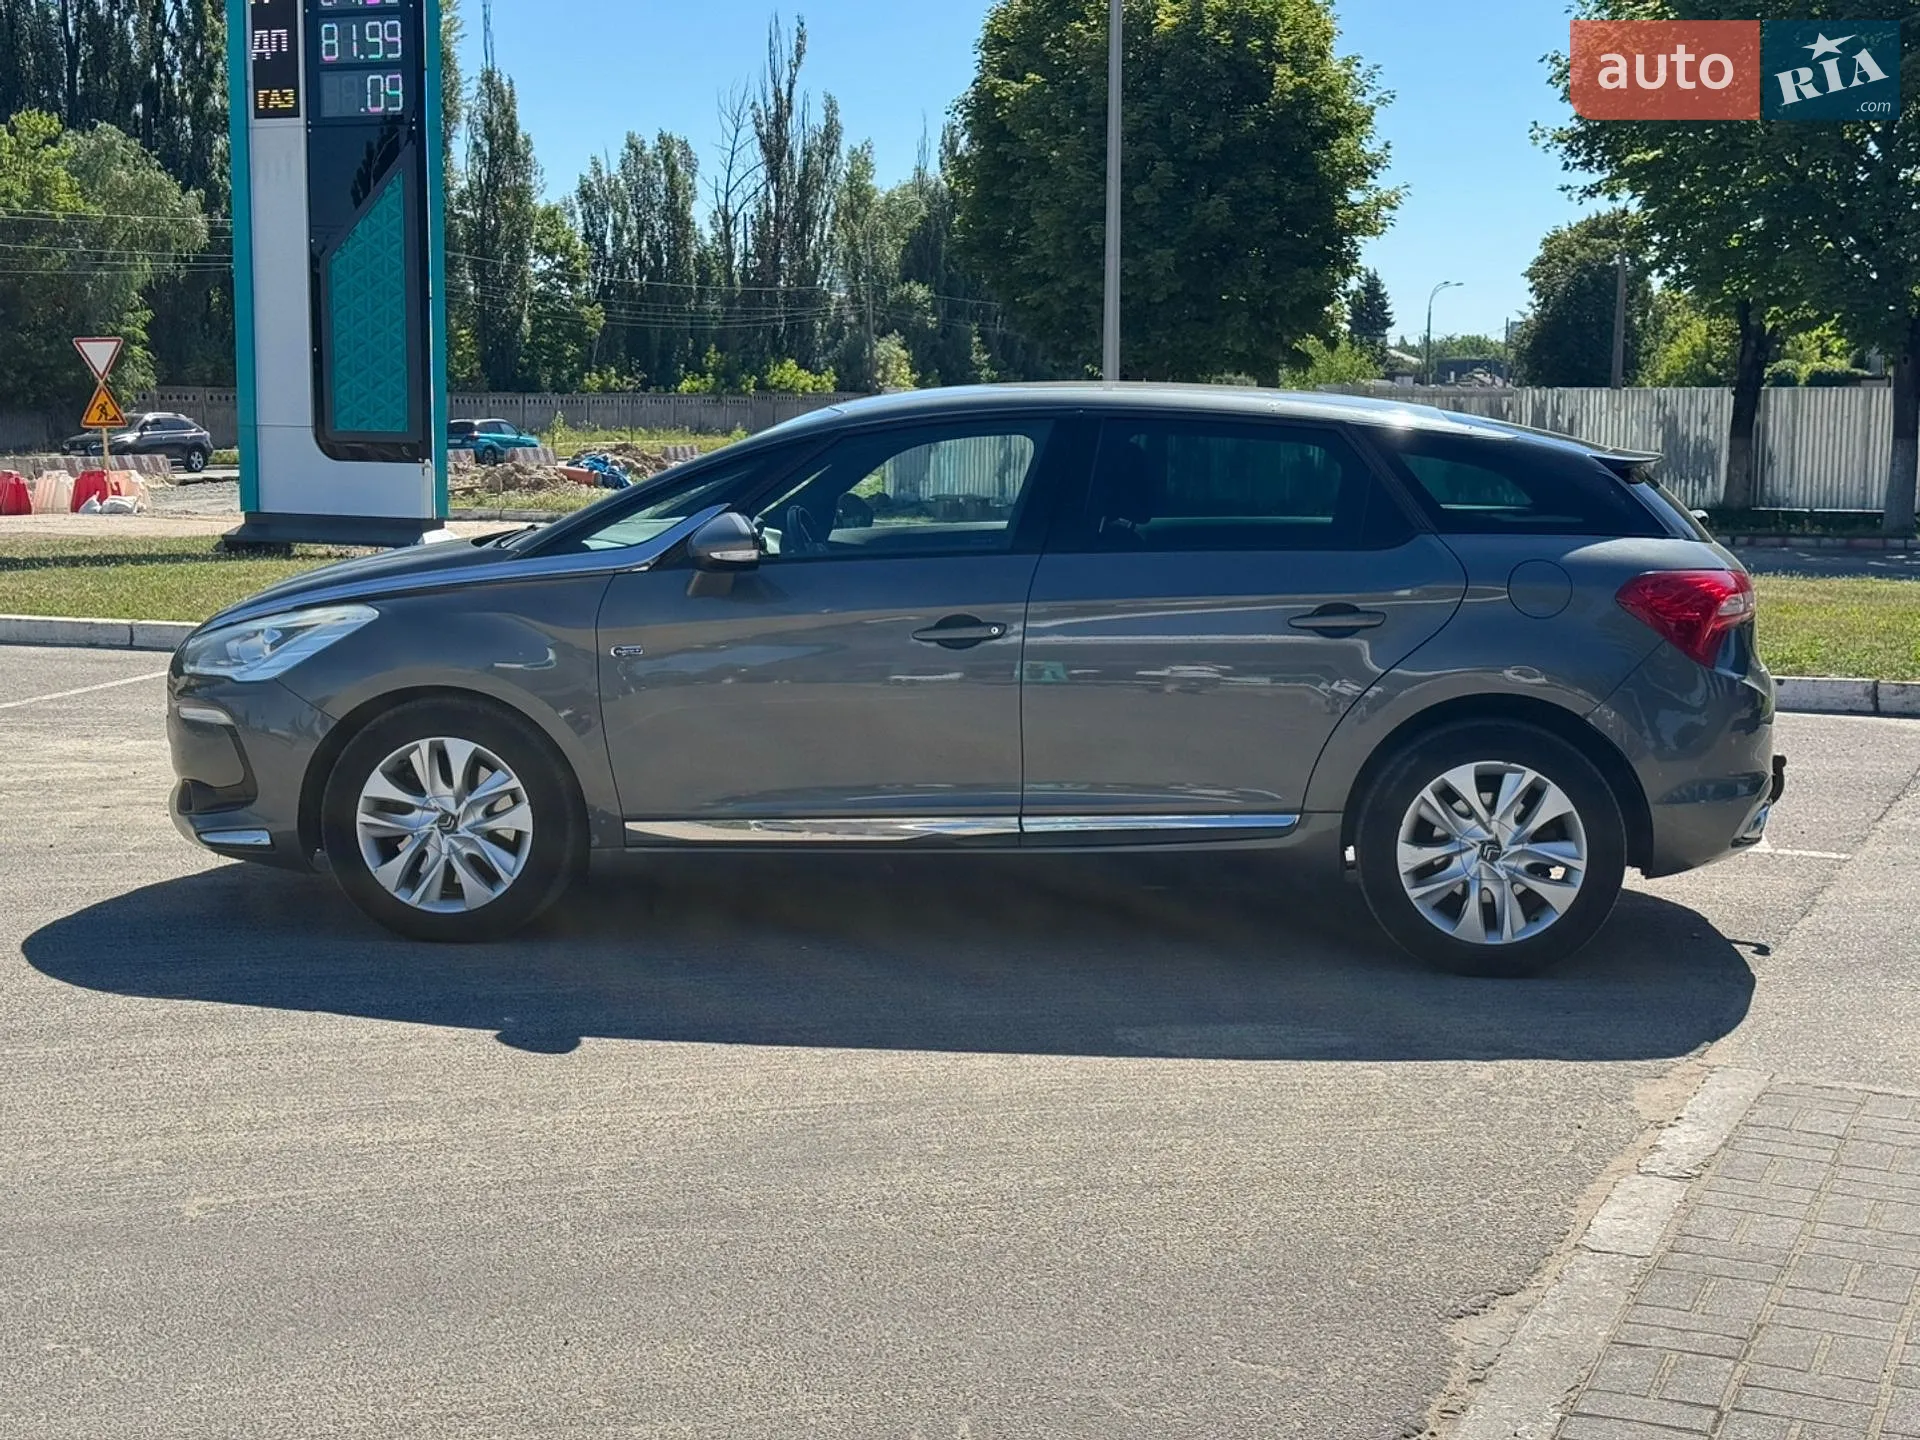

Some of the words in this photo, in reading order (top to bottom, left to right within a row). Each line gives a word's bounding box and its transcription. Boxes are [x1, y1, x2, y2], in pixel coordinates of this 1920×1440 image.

[251, 29, 288, 60] ДП
[321, 20, 401, 62] 81.99
[257, 88, 295, 109] ГАЗ
